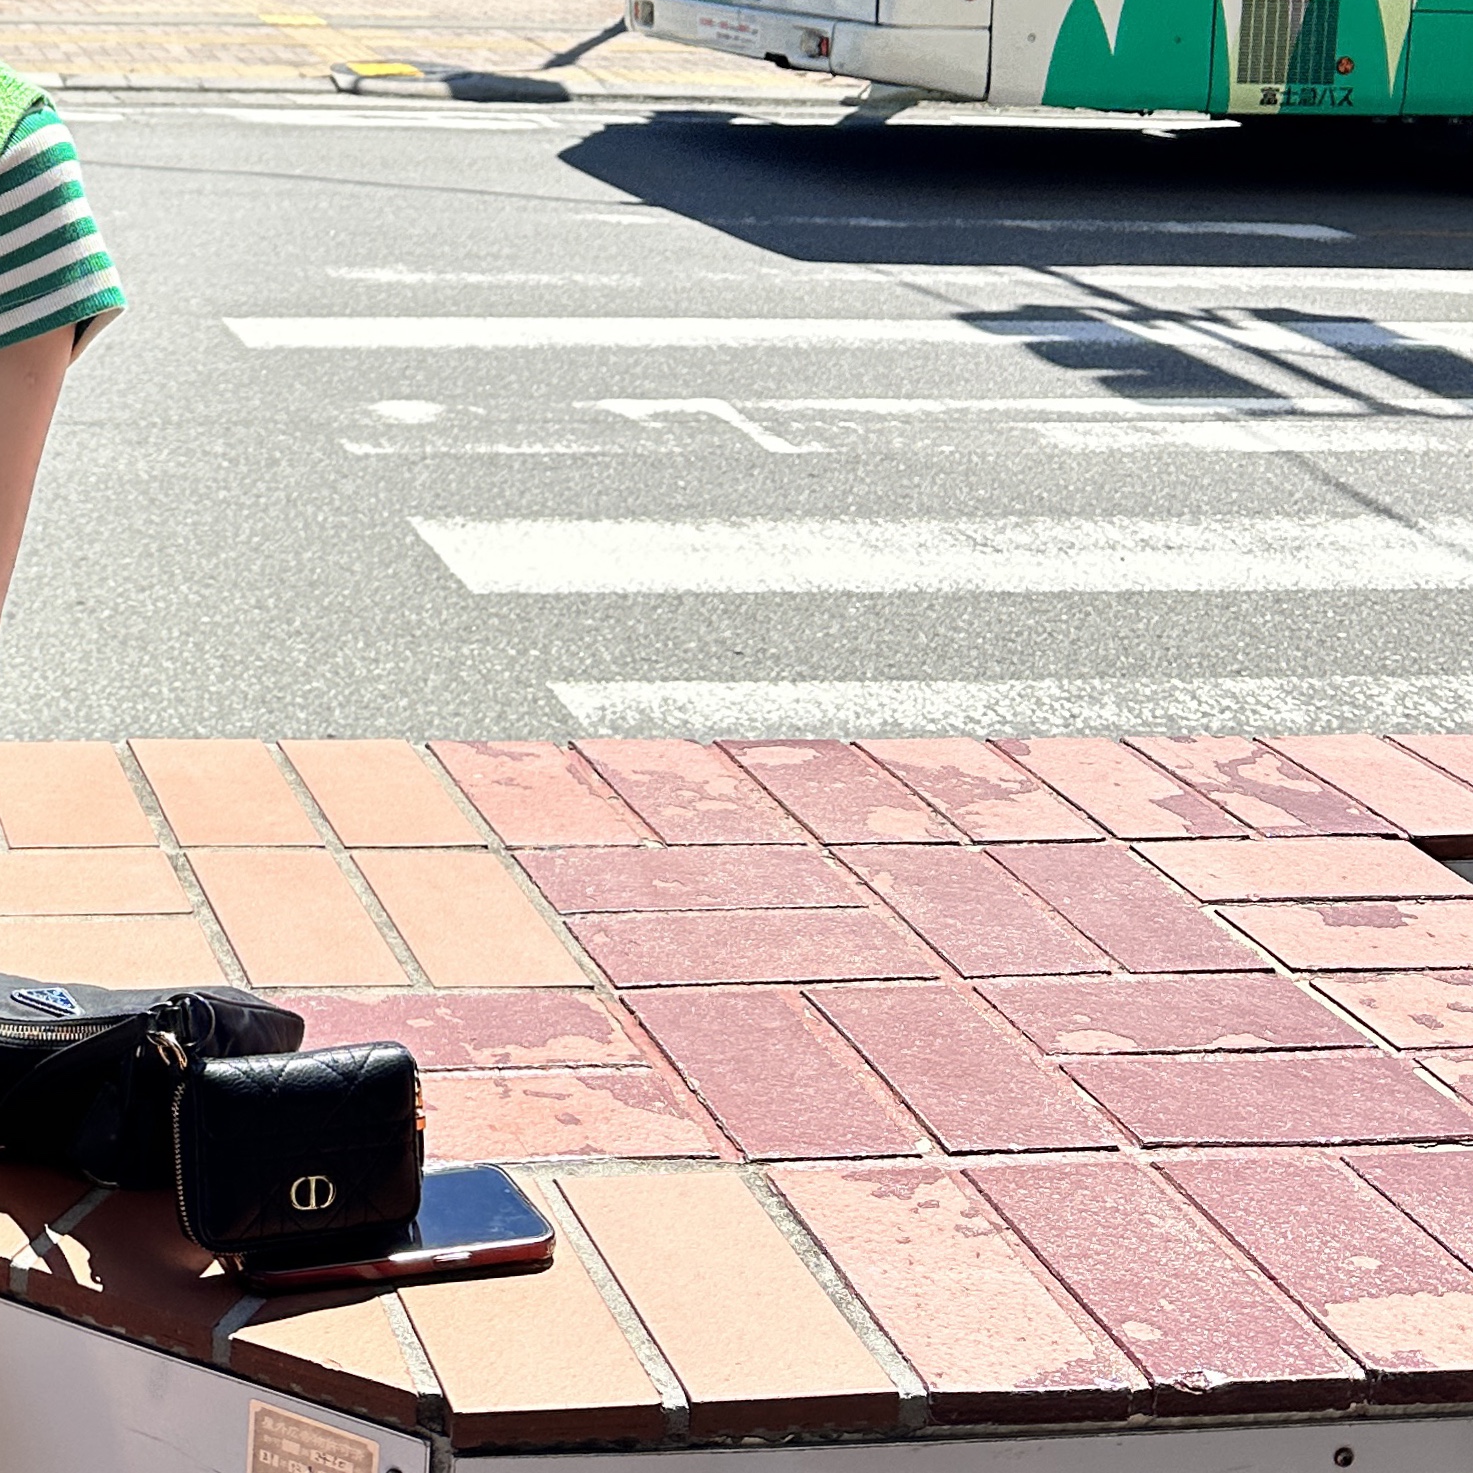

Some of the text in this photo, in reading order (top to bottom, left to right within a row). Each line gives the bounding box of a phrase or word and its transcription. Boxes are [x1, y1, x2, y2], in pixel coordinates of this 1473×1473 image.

[1259, 86, 1354, 108] 富士急バス
